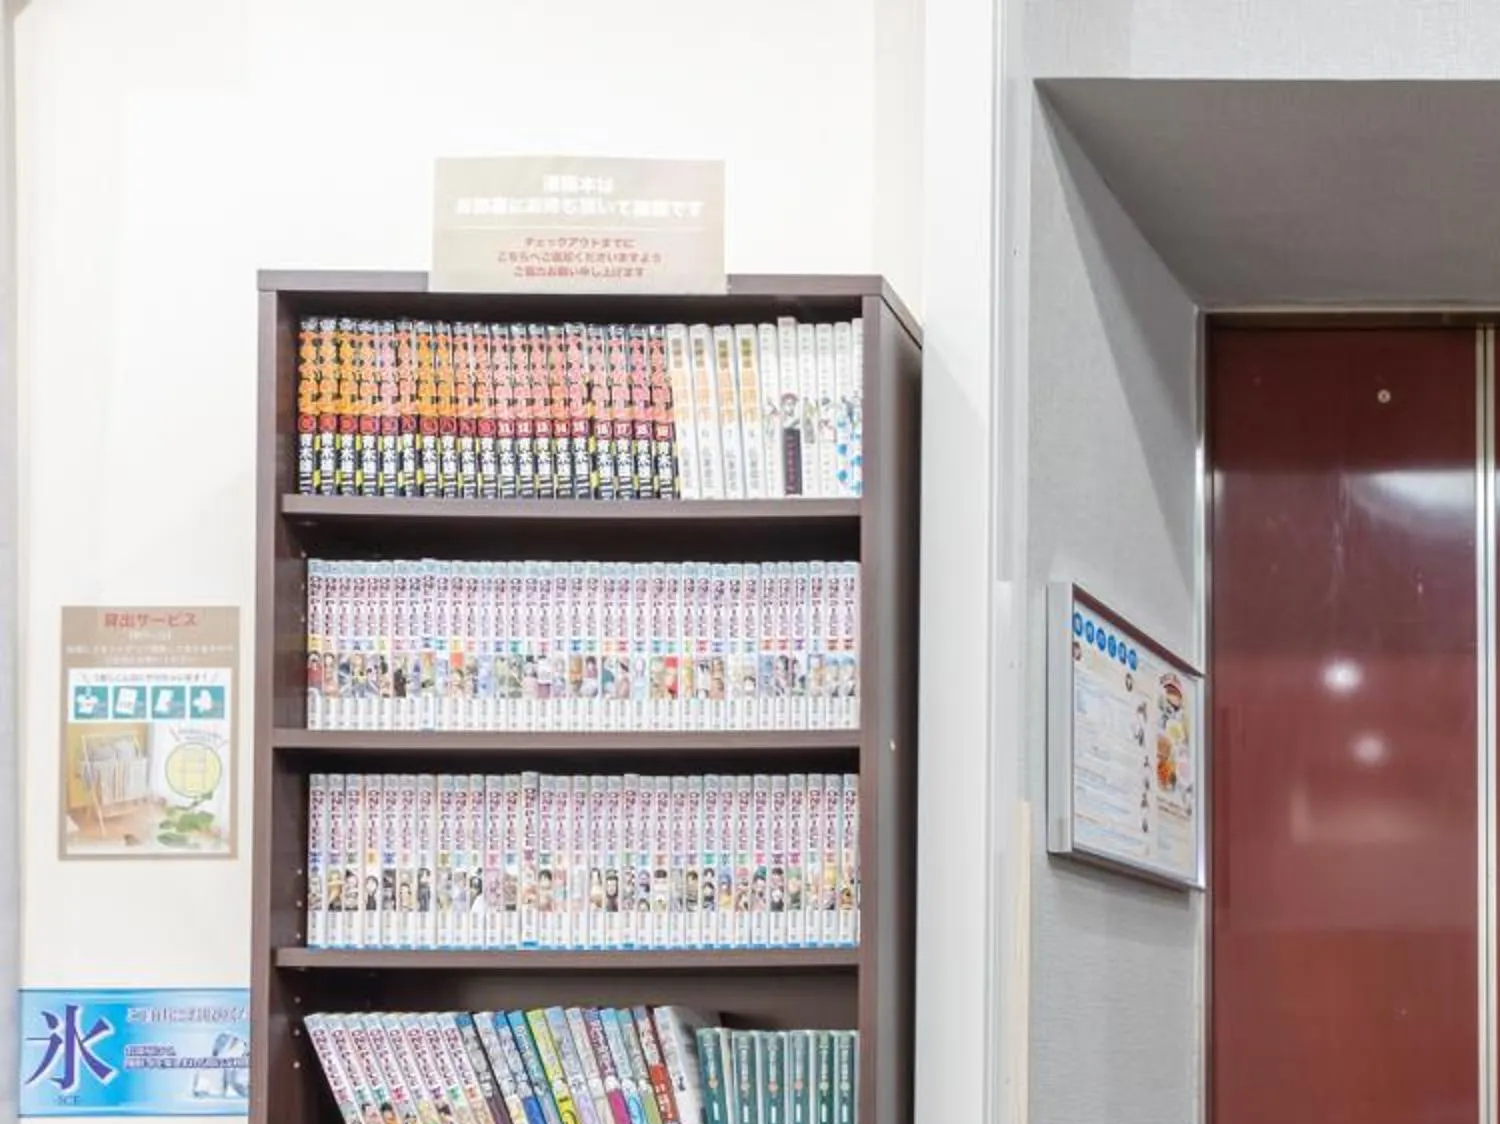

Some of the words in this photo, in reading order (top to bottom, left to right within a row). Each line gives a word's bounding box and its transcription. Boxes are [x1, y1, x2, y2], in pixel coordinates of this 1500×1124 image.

[525, 237, 635, 248] チェックアウトまでに
[104, 612, 197, 628] 貸出サービス
[23, 1003, 115, 1091] 氷
